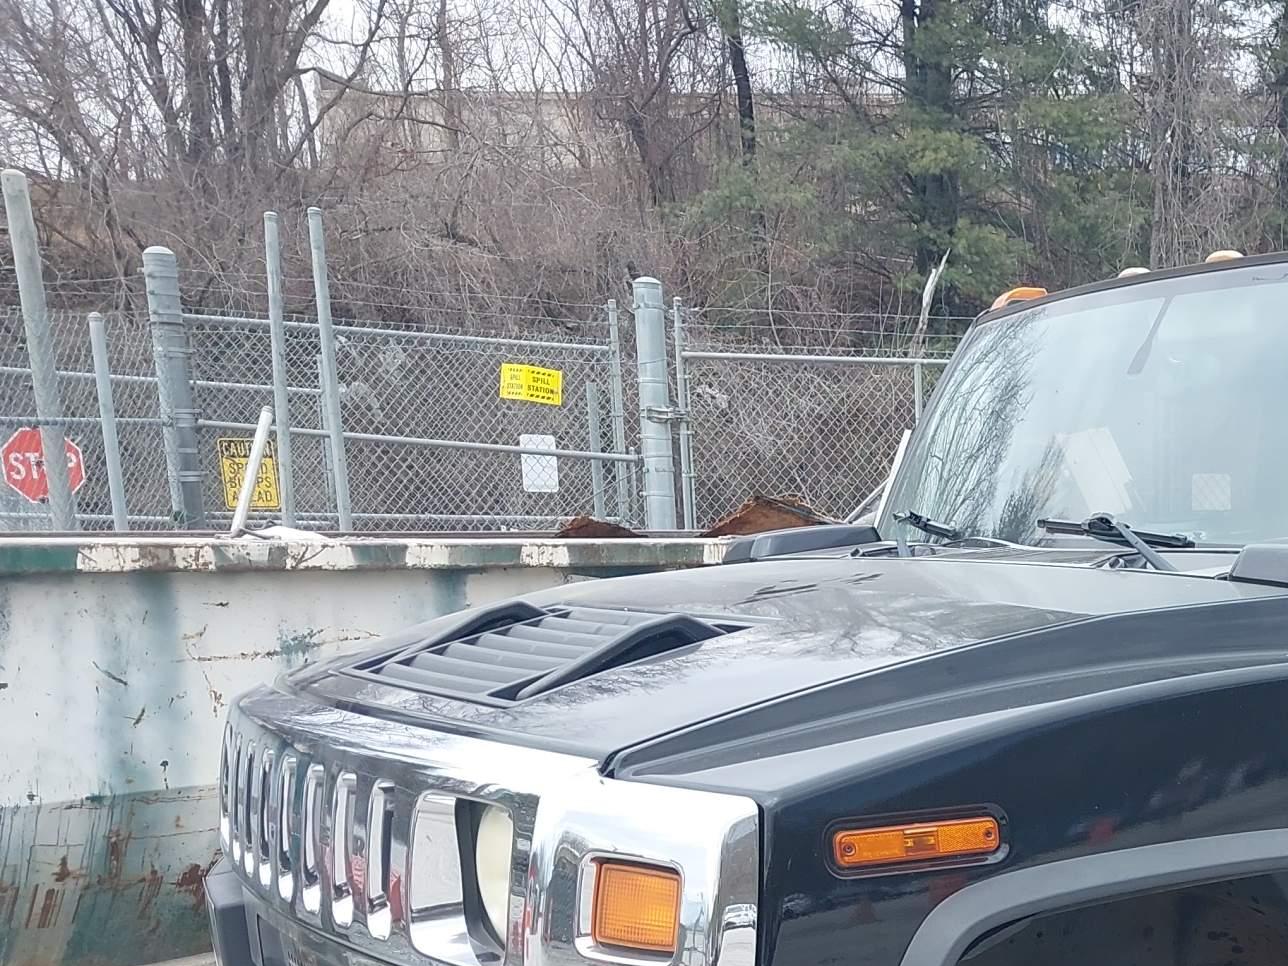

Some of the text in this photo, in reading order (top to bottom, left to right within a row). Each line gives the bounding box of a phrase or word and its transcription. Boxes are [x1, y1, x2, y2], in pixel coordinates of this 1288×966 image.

[531, 376, 551, 385] SPILL
[527, 384, 554, 395] STATION
[222, 441, 272, 457] CAUTN
[9, 452, 77, 479] STP
[229, 462, 268, 475] SPD
[228, 476, 272, 489] BPS
[232, 490, 273, 502] AAD
